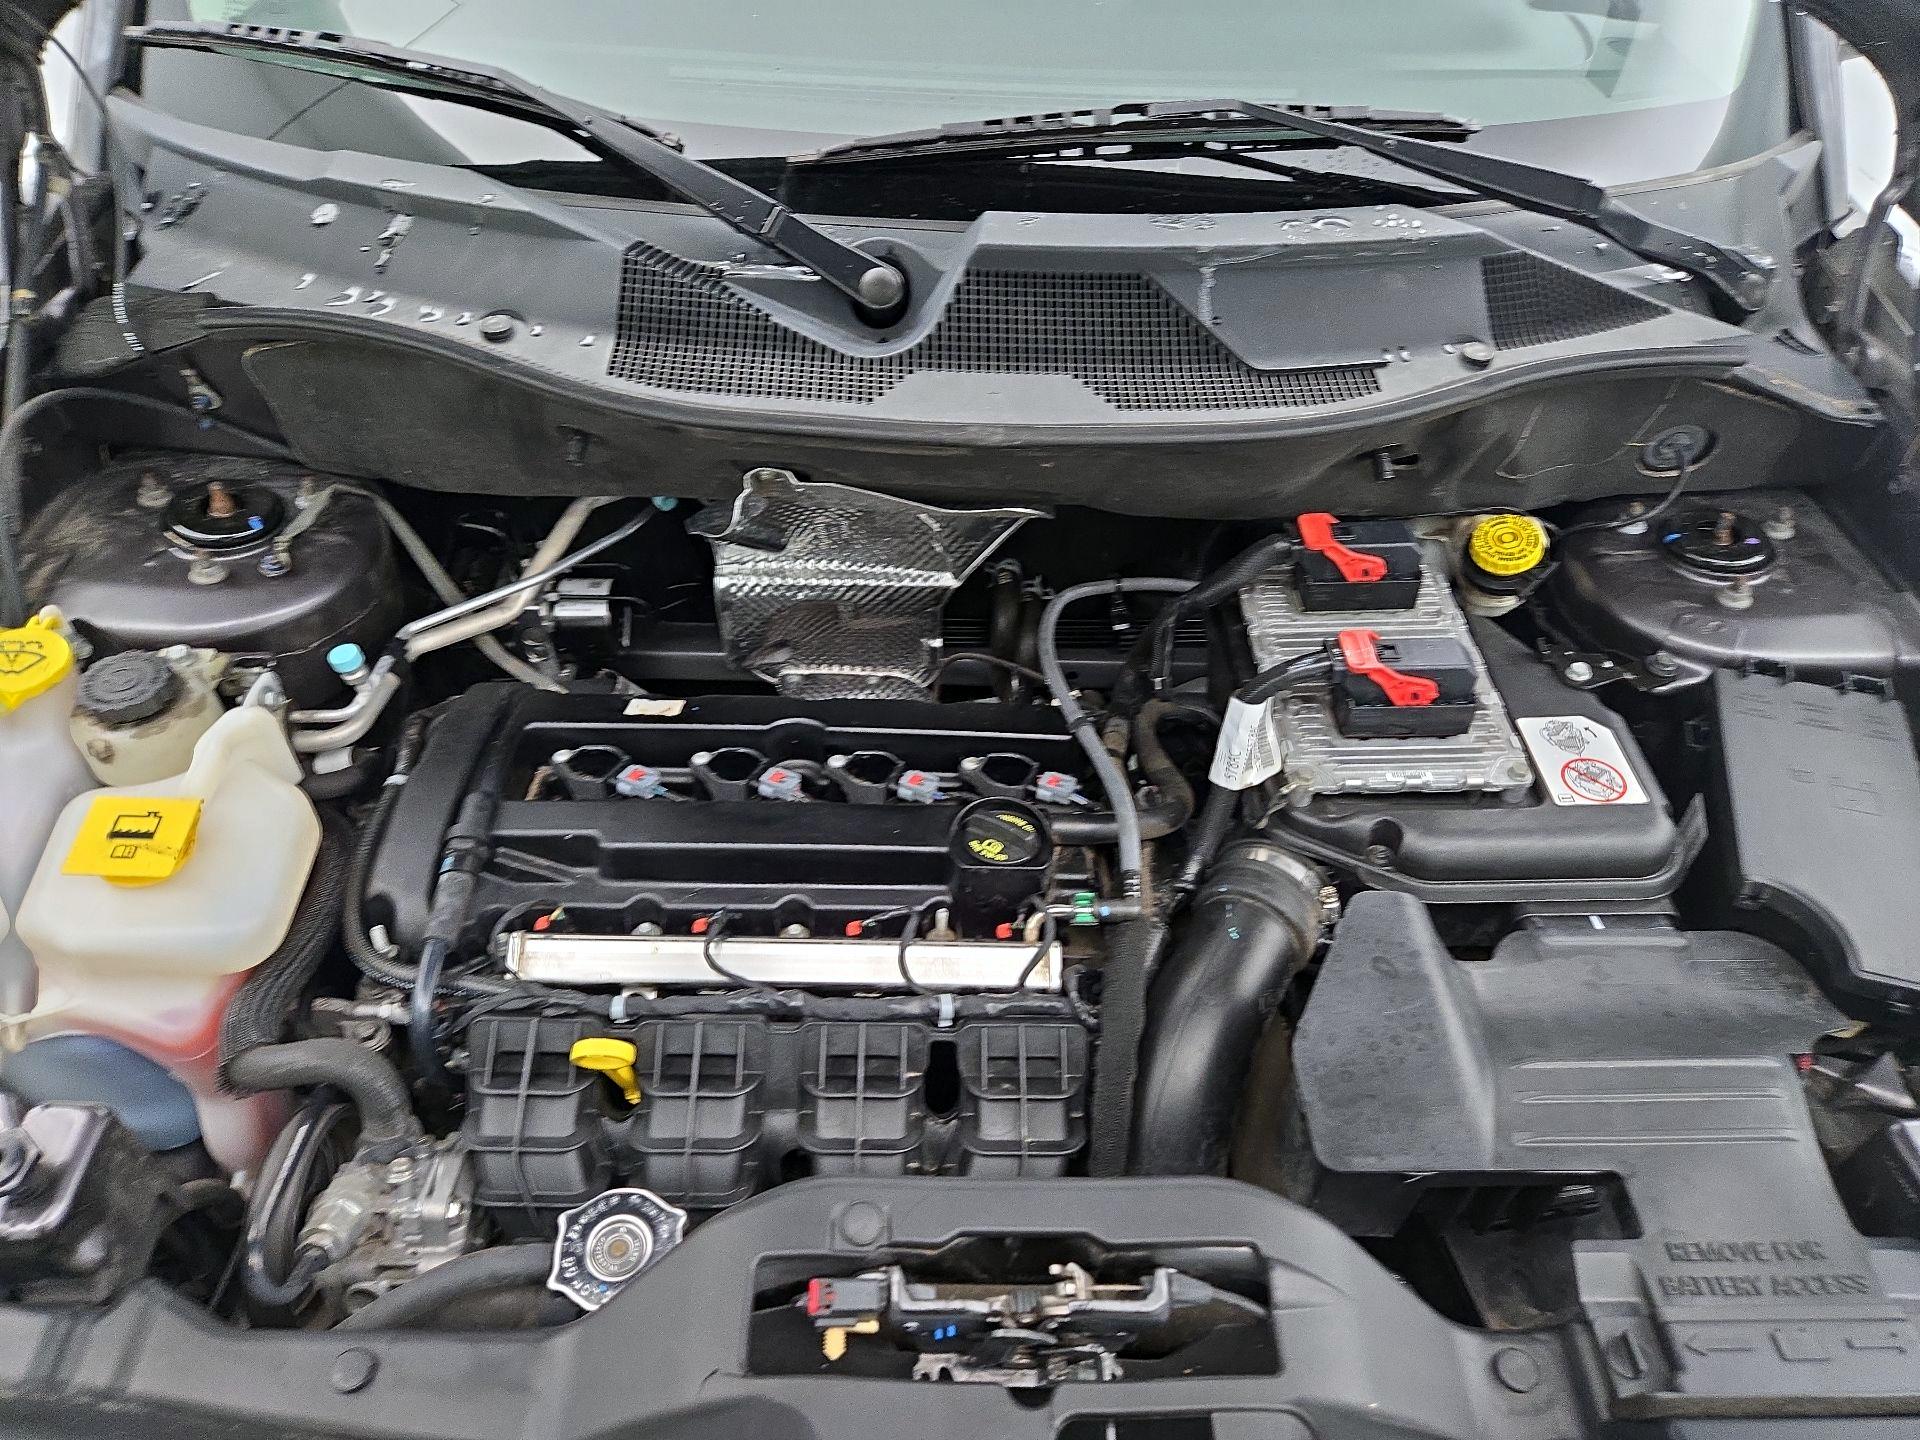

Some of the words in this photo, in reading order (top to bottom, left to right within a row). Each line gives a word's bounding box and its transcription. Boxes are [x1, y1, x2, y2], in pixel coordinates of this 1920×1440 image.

[1665, 1241, 1769, 1263] REMOVE
[1770, 1240, 1827, 1261] FOR
[1658, 1274, 1763, 1297] BATTERY
[1769, 1273, 1869, 1297] ACCESS
